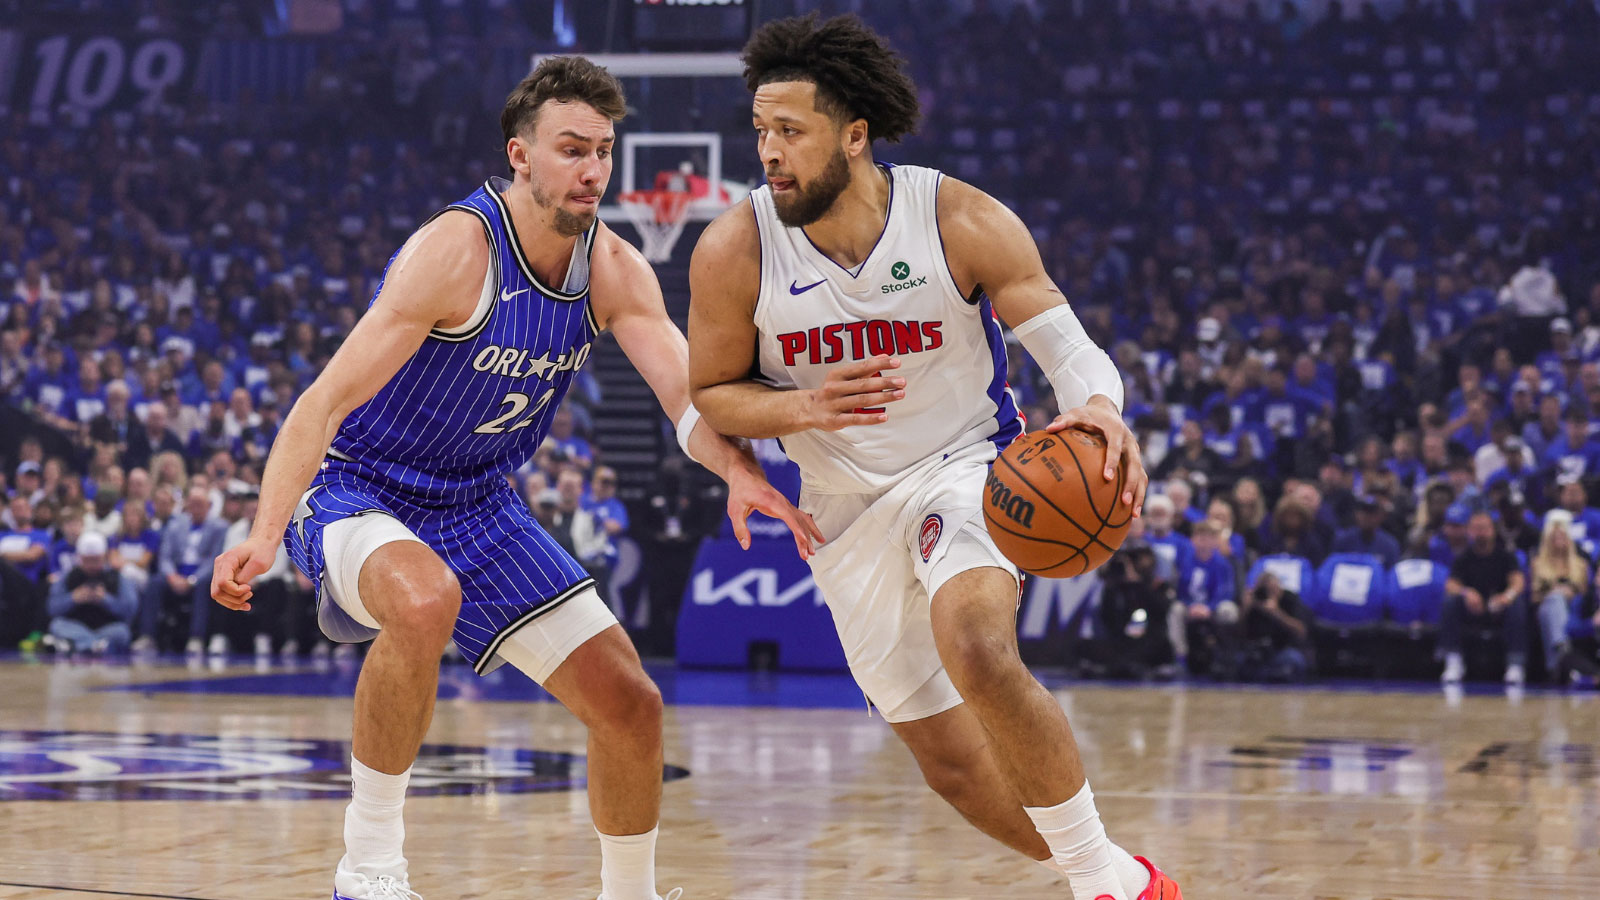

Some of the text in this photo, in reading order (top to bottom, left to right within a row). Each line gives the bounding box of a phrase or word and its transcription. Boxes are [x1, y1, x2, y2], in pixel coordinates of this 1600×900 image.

[28, 35, 185, 120] 109
[881, 275, 928, 294] StockX
[776, 319, 943, 367] PISTONS
[985, 469, 1036, 530] Wilso
[746, 519, 791, 538] oogle
